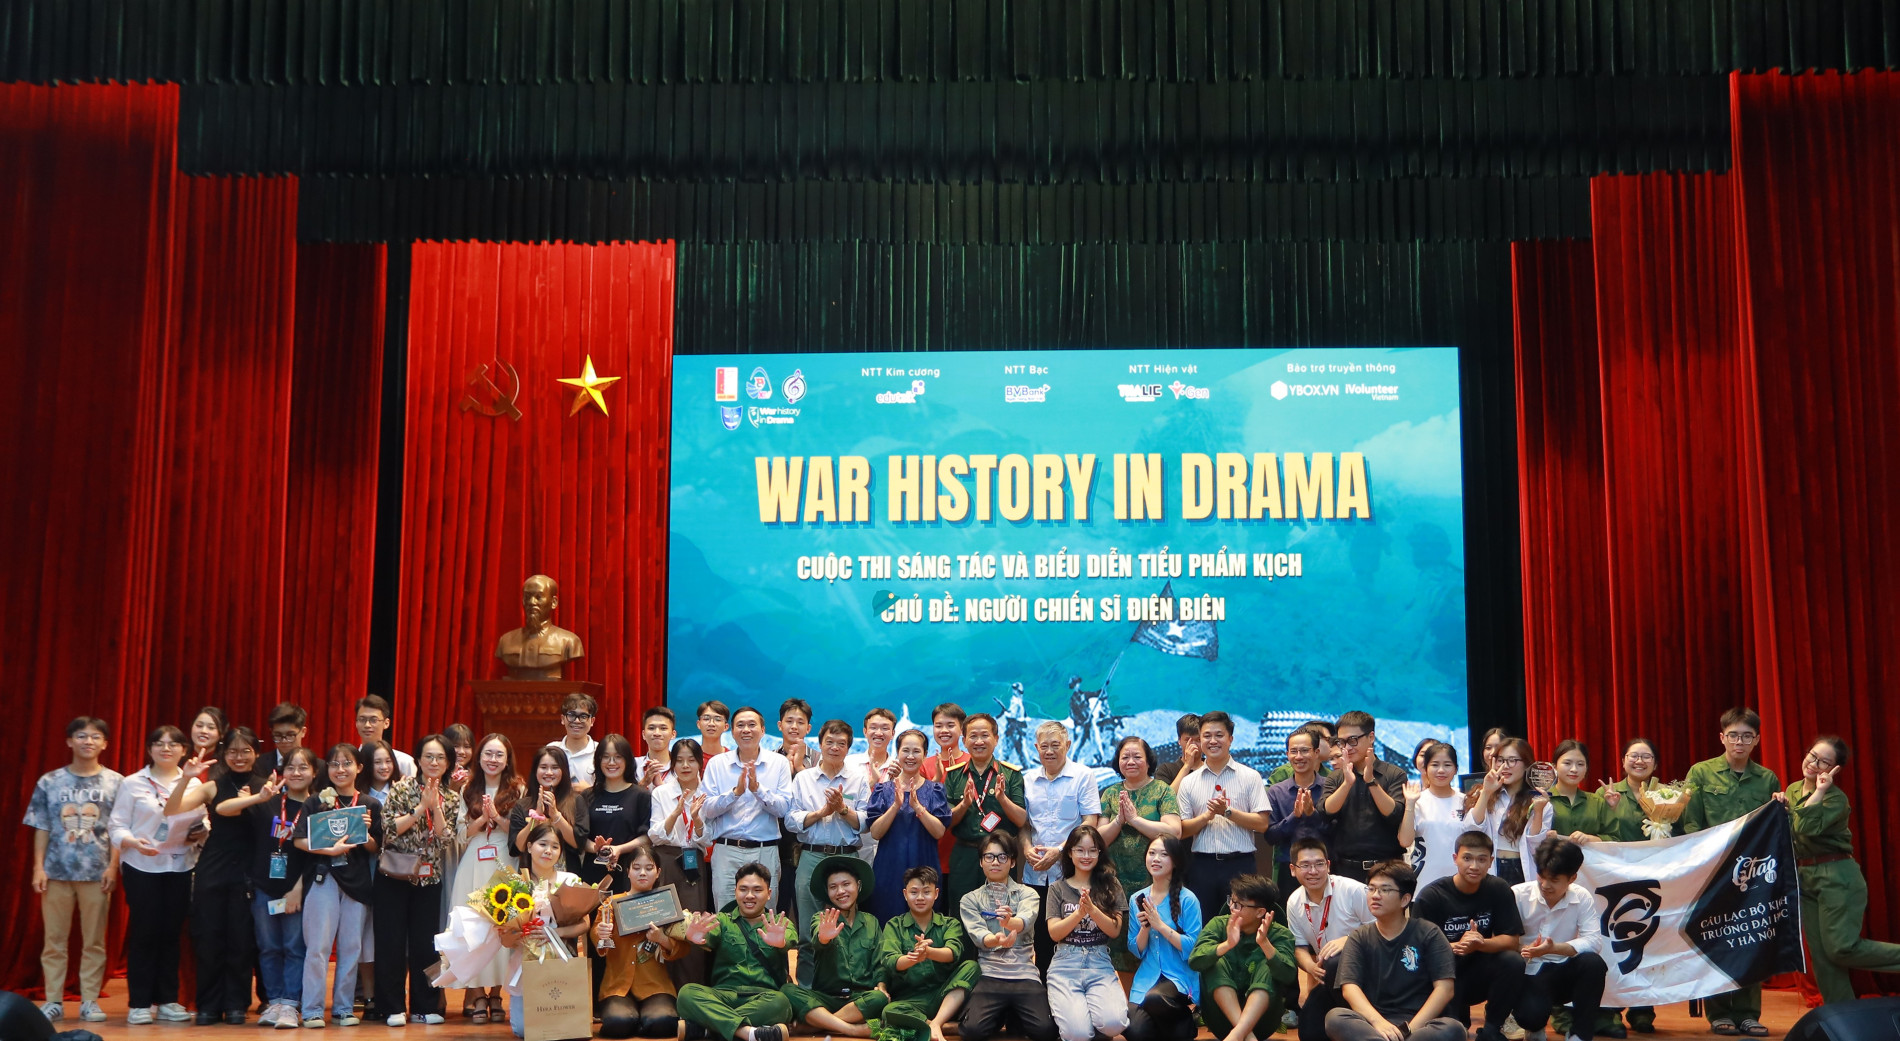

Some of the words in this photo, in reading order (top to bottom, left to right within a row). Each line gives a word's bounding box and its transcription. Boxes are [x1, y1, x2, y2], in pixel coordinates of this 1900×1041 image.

[862, 368, 882, 376] NTT
[886, 367, 904, 376] Kim
[1005, 366, 1025, 374] NTT
[1030, 365, 1048, 375] Bạc
[1129, 365, 1150, 373] NTT
[1154, 364, 1177, 375] Hiện
[1181, 364, 1198, 374] vật
[1328, 362, 1362, 375] truyền
[1366, 363, 1396, 375] thông
[1289, 385, 1339, 396] YBOX.VN
[755, 455, 872, 524] WAR
[888, 453, 1096, 523] HISTORY
[1113, 452, 1163, 521] IN
[1181, 451, 1370, 520] DRAMA
[797, 552, 852, 584] CUỘC
[858, 555, 892, 580] THI
[897, 551, 951, 580] SÁNG
[957, 551, 996, 579] TÁC
[1001, 551, 1029, 578] VÀ
[1035, 546, 1080, 578] BIỂU
[1086, 547, 1133, 578] DIỄN
[1138, 546, 1182, 578] TIỂU
[1189, 546, 1247, 578] PHẨM
[1253, 553, 1302, 581] KỊCH
[880, 593, 923, 622] CHỦ
[928, 591, 960, 622] ĐỀ:
[965, 594, 1028, 622] NGƯỜI
[1034, 590, 1094, 622] CHIẾN
[1100, 594, 1121, 622] SĨ
[1127, 593, 1174, 626] ĐIỆN
[1180, 593, 1225, 621] BIÊN
[60, 788, 105, 802] GUCCI
[1724, 908, 1748, 922] LẠC
[1749, 902, 1766, 917] BỘ
[1773, 908, 1789, 922] HC
[1727, 938, 1735, 948] Y
[1738, 932, 1756, 945] HÀ
